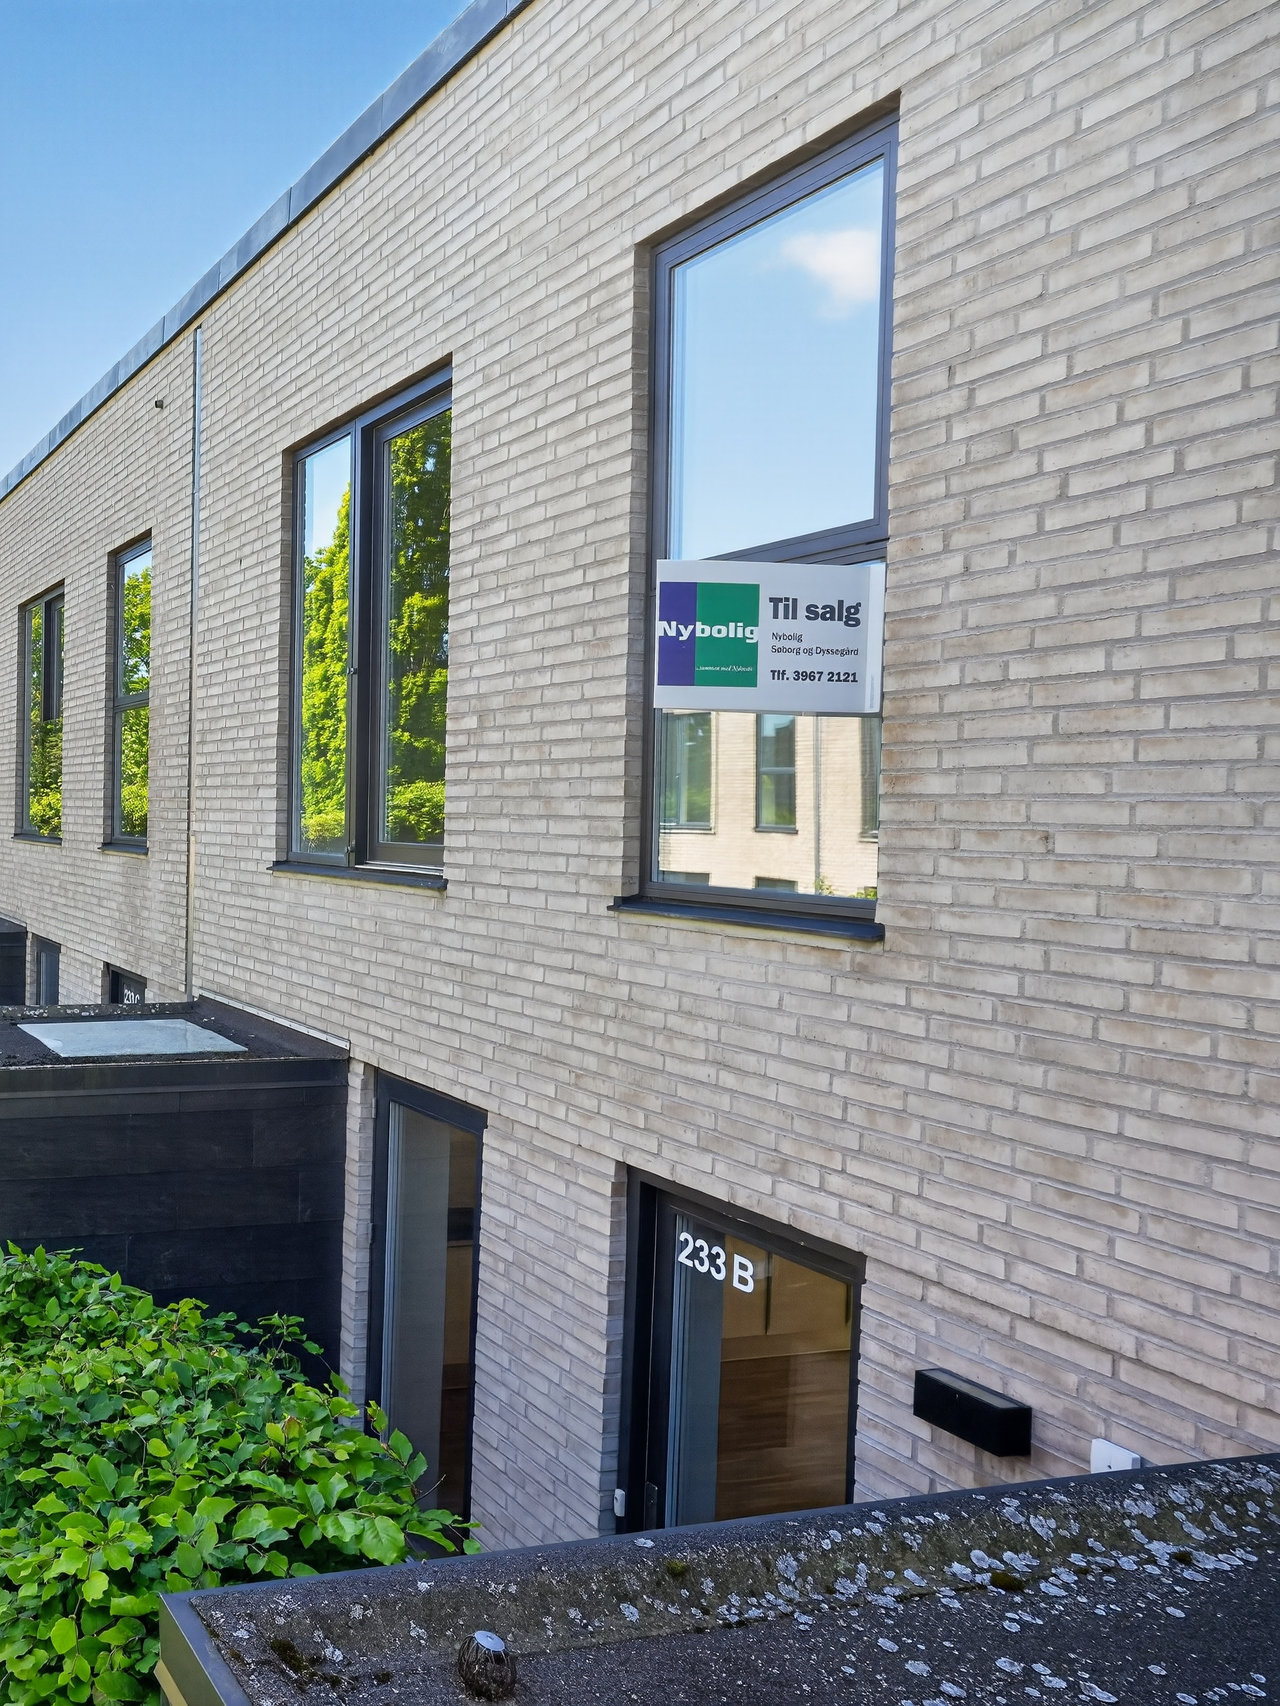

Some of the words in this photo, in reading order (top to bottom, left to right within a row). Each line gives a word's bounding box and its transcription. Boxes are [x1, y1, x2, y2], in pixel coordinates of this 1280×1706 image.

[769, 597, 798, 620] Til
[805, 600, 862, 627] salg
[658, 621, 759, 643] Nybolig
[772, 632, 803, 643] Nybolig
[771, 645, 801, 656] Søborg
[803, 648, 813, 656] og
[815, 646, 859, 657] Dyssegård
[770, 669, 790, 681] Tlf.
[793, 670, 824, 682] 3967
[827, 671, 858, 683] 2121
[678, 1232, 726, 1281] 233
[732, 1253, 754, 1293] B
